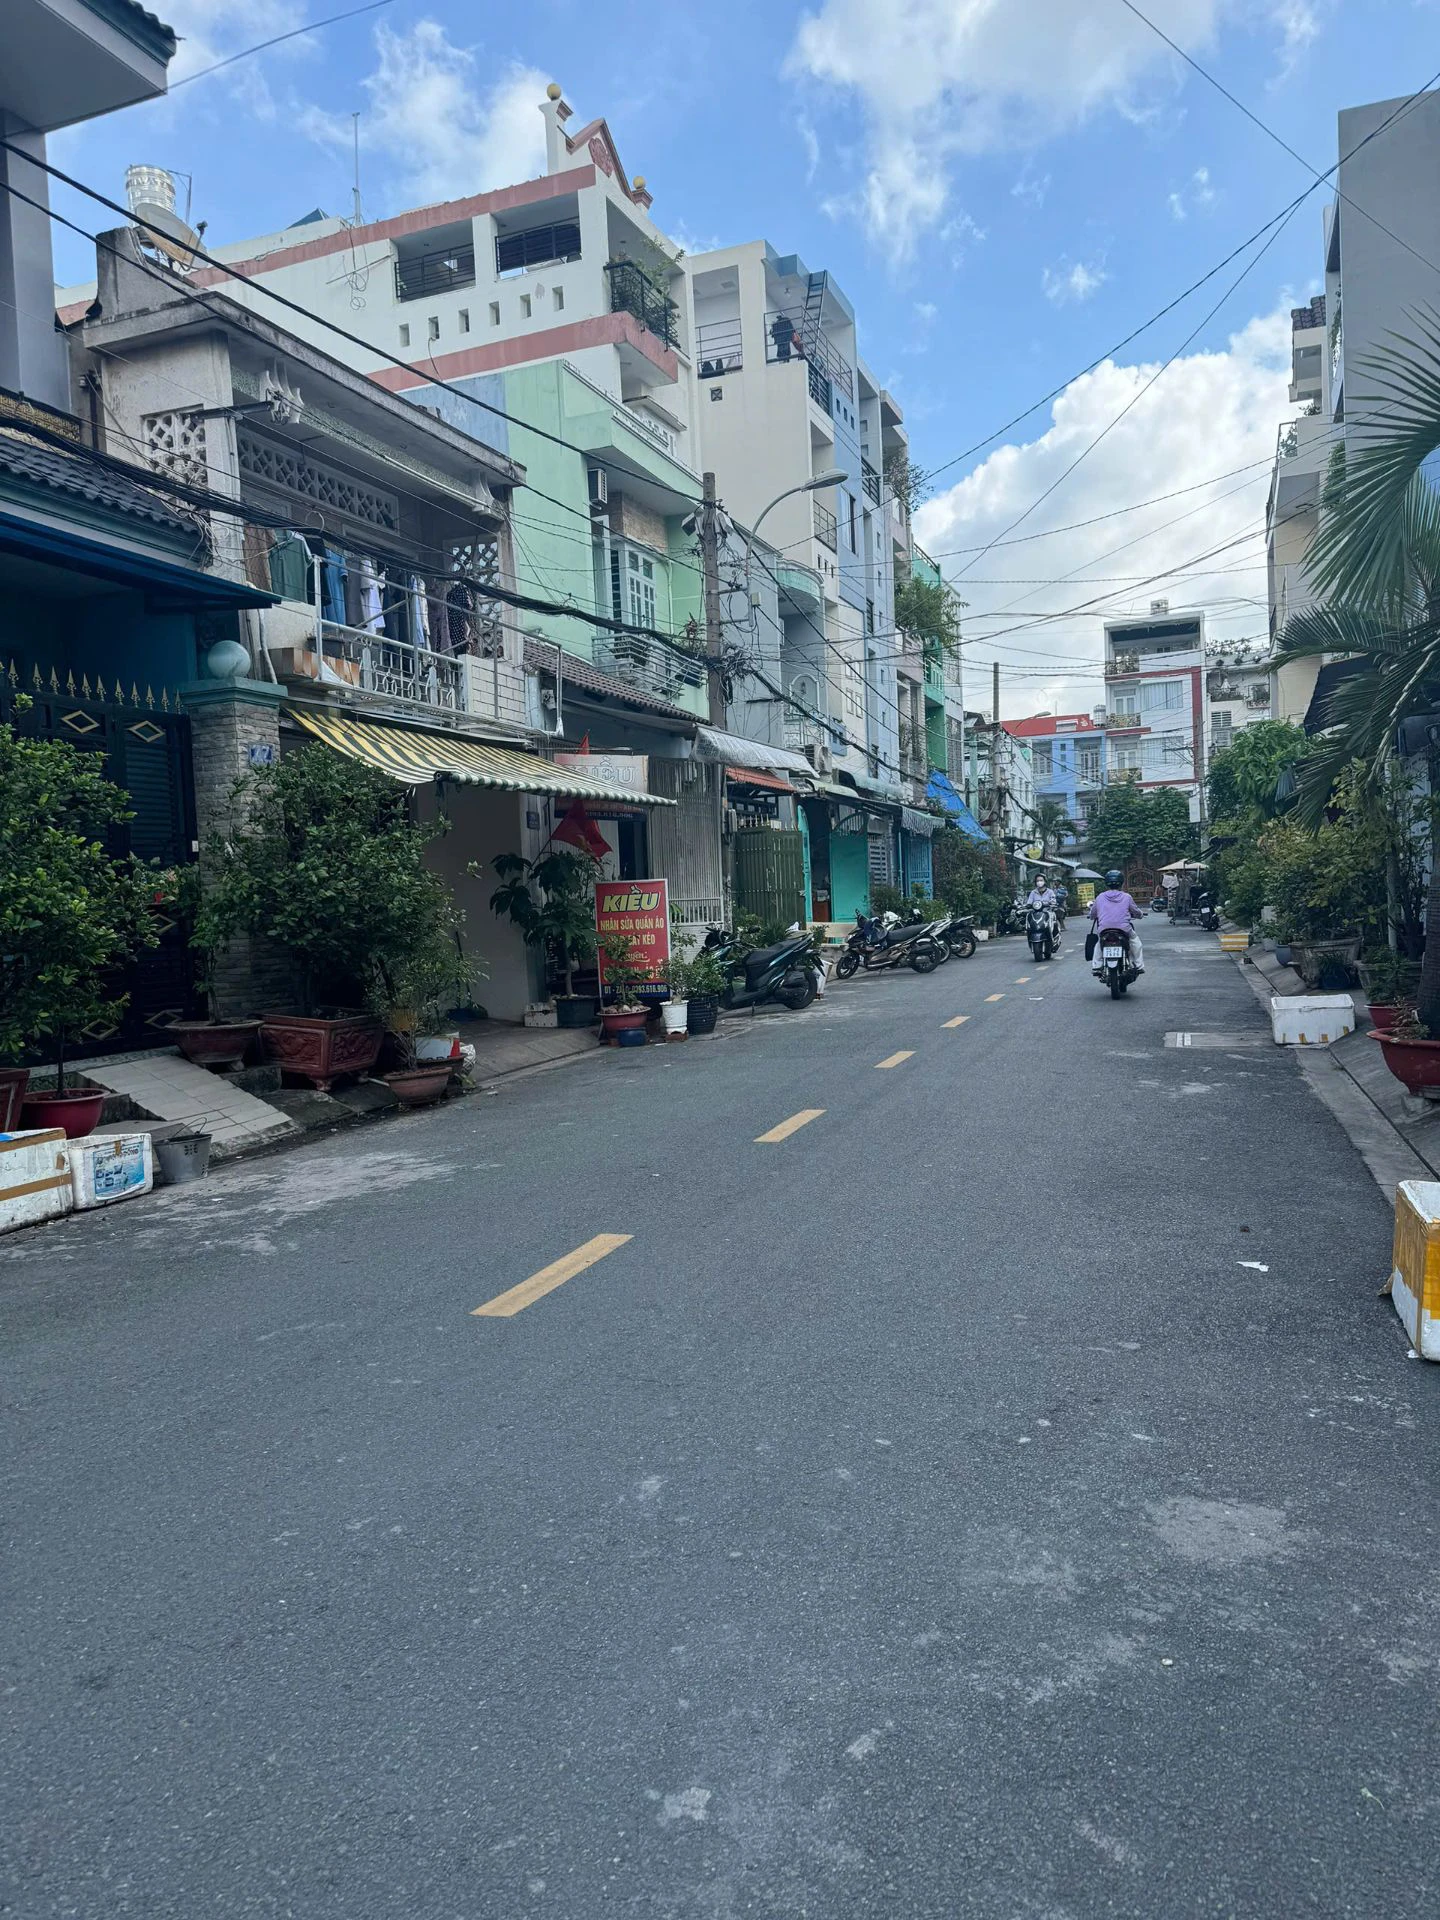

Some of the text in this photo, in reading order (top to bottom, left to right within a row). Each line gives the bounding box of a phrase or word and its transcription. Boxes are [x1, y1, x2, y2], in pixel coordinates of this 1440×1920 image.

[602, 884, 660, 912] KIỀU
[655, 915, 665, 929] ÁO
[642, 931, 656, 945] KÉO
